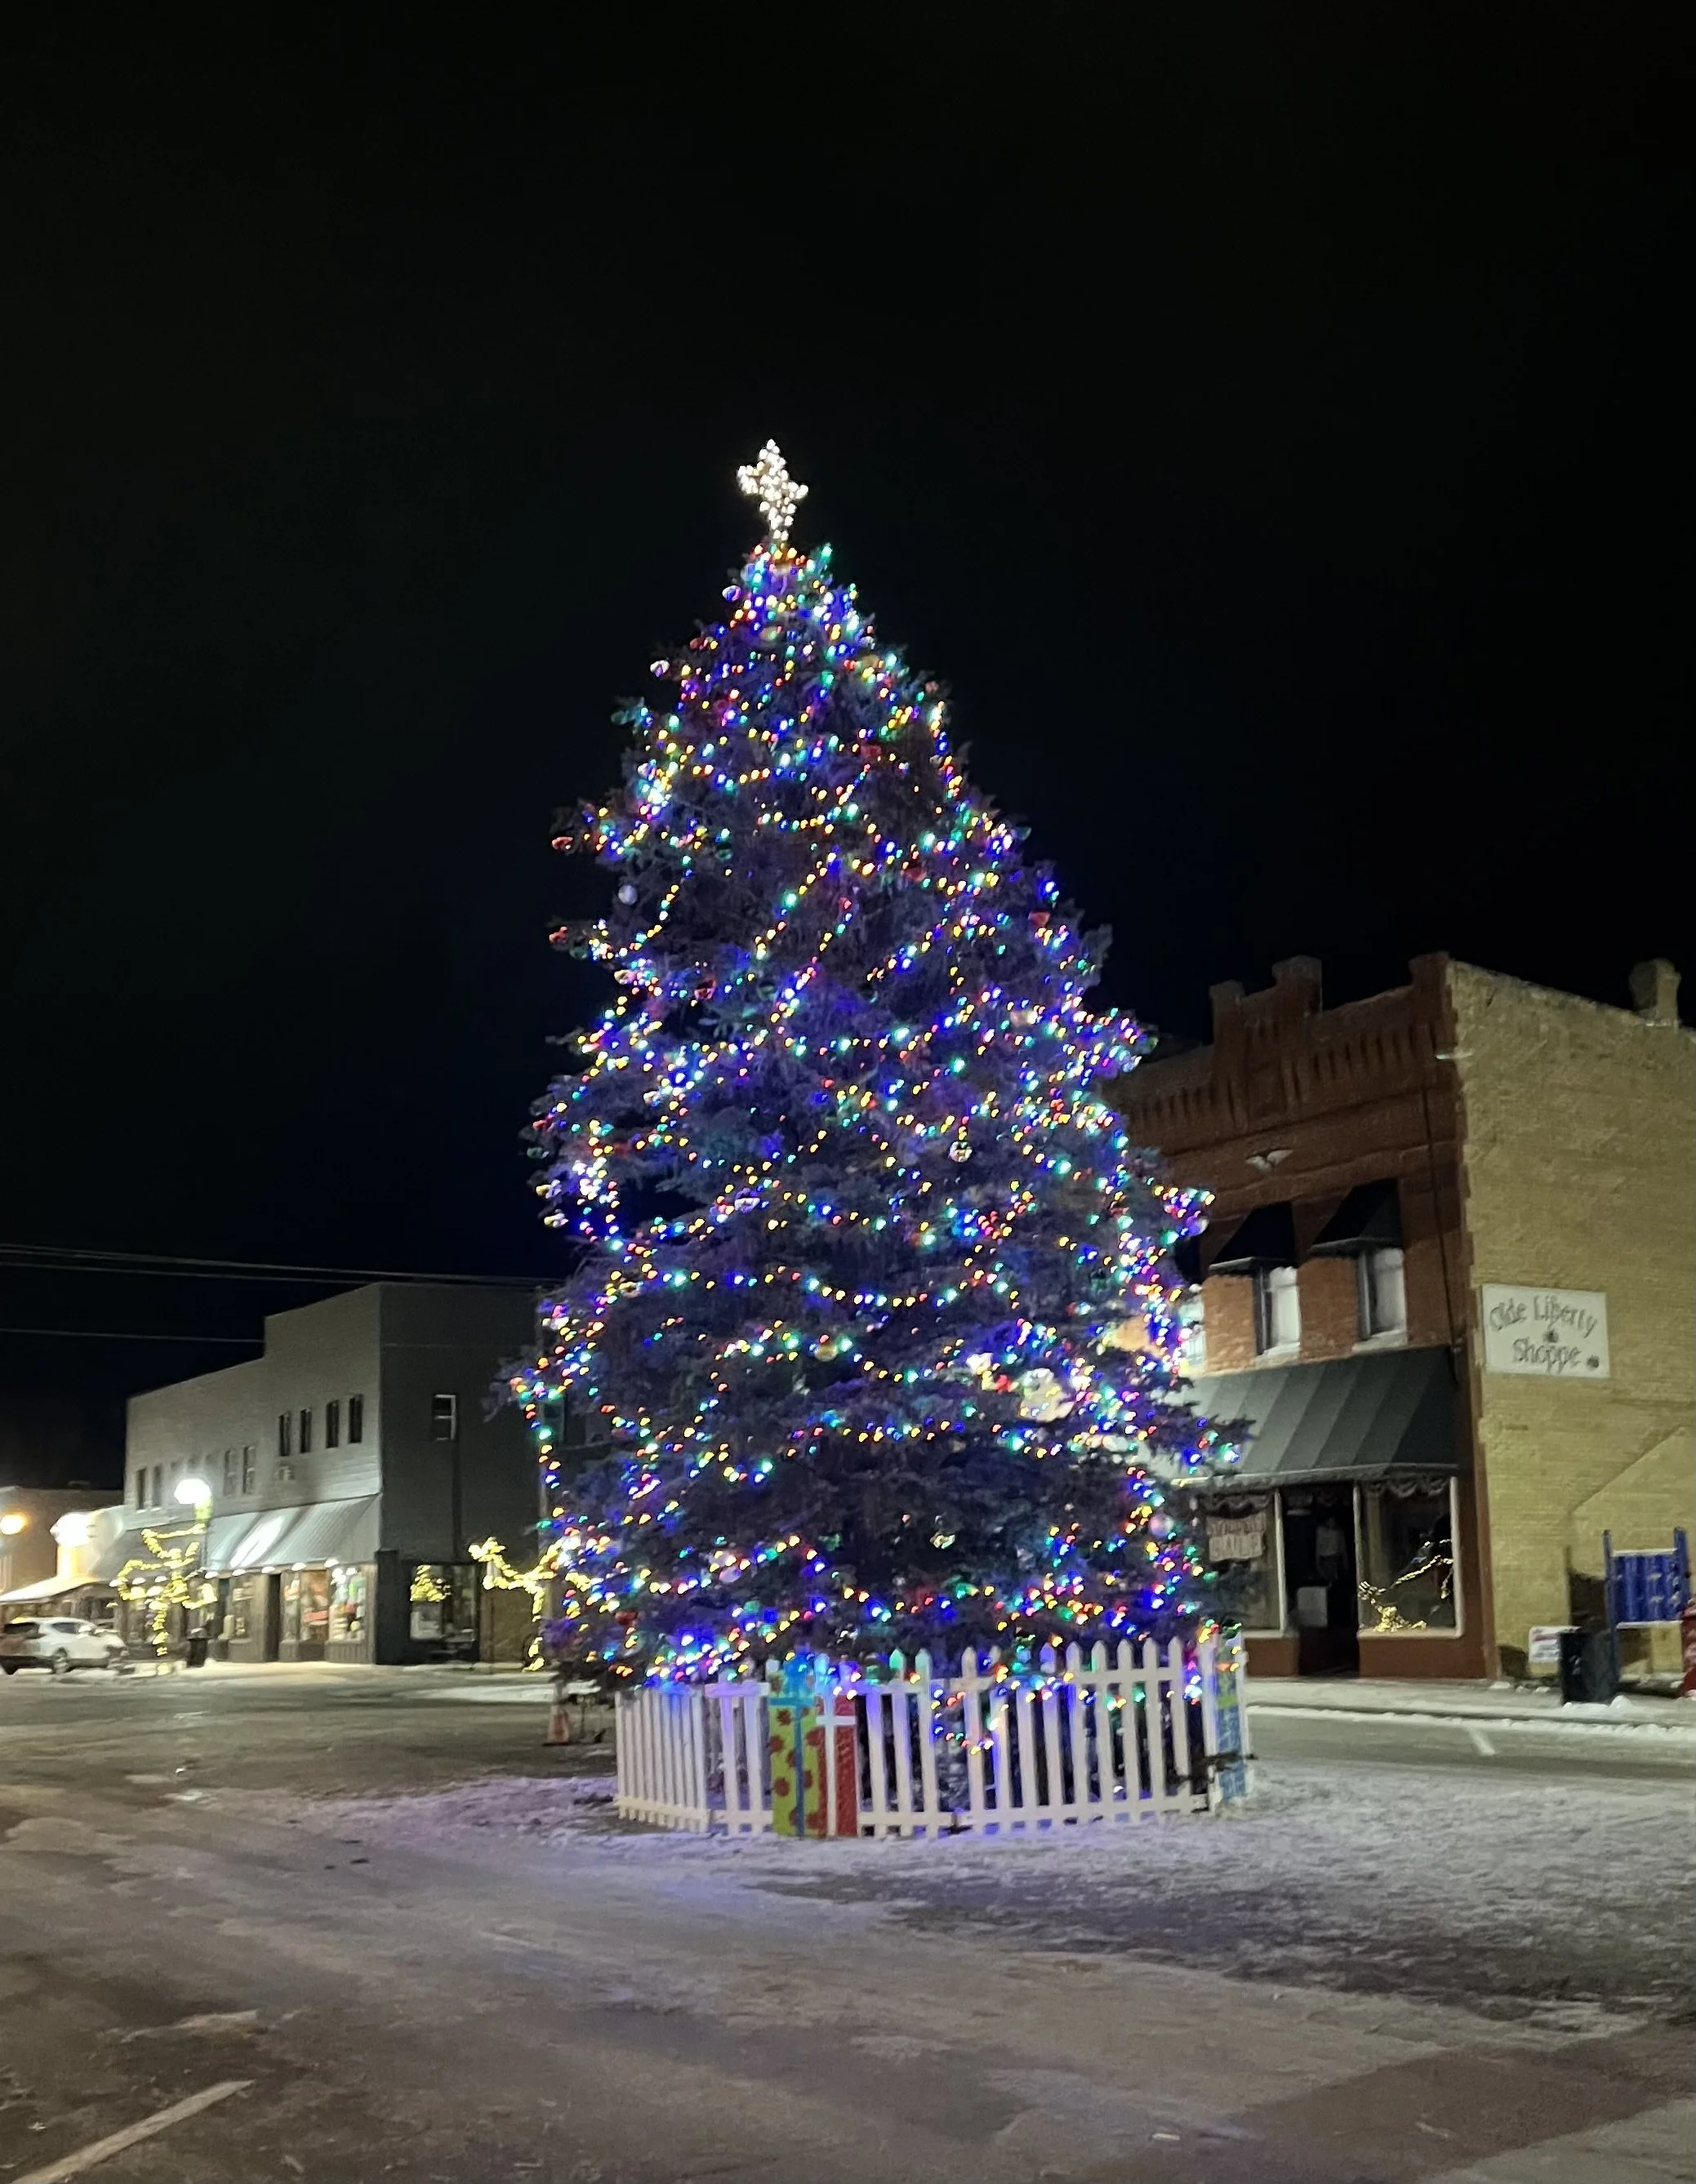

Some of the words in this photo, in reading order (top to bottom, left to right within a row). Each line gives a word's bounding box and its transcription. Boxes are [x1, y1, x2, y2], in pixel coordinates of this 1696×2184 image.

[1489, 1298, 1527, 1330] Olde
[1534, 1295, 1598, 1338] Liberty
[1512, 1337, 1581, 1374] Shoppe
